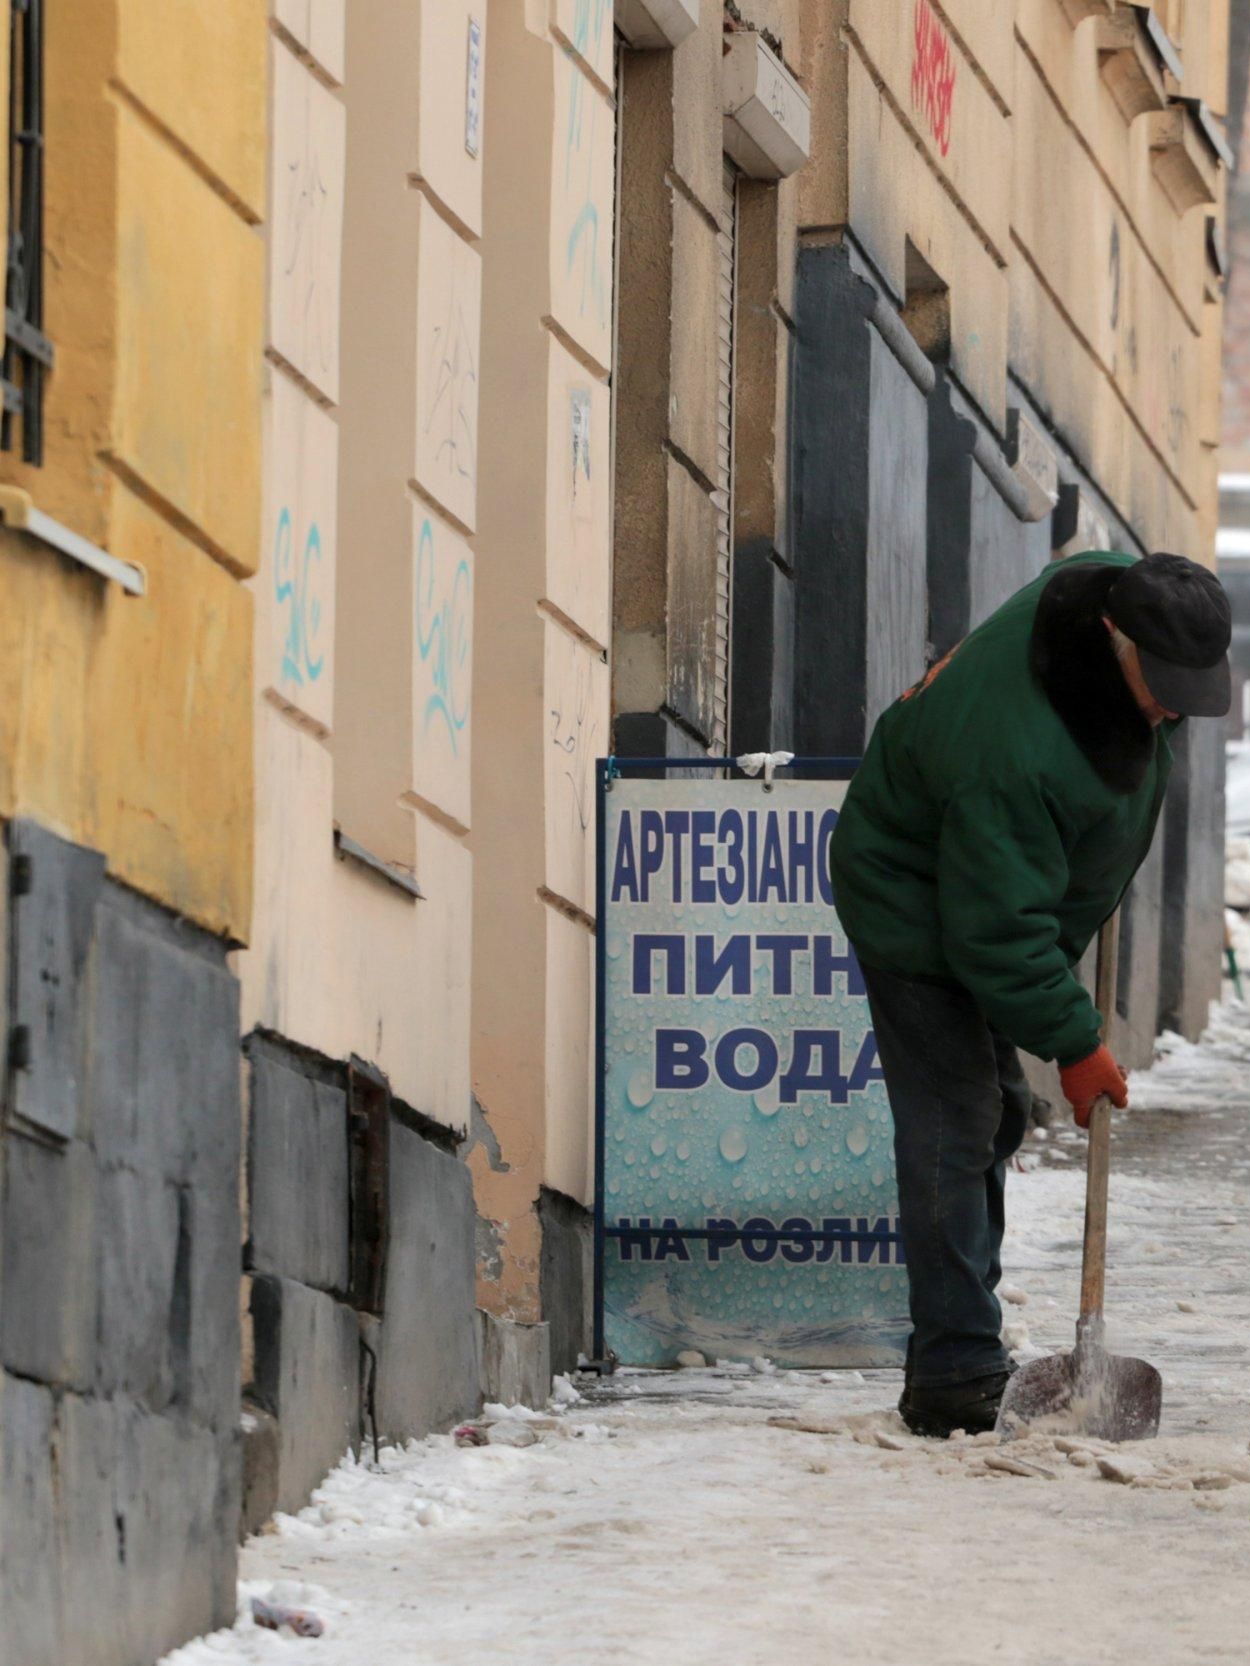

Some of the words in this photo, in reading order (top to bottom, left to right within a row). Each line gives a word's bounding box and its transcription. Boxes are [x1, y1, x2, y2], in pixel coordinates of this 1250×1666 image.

[632, 933, 867, 996] ПИТН
[655, 1027, 886, 1104] ВОДА
[618, 1217, 690, 1261] НА
[705, 1216, 907, 1265] РОЗЛИ
